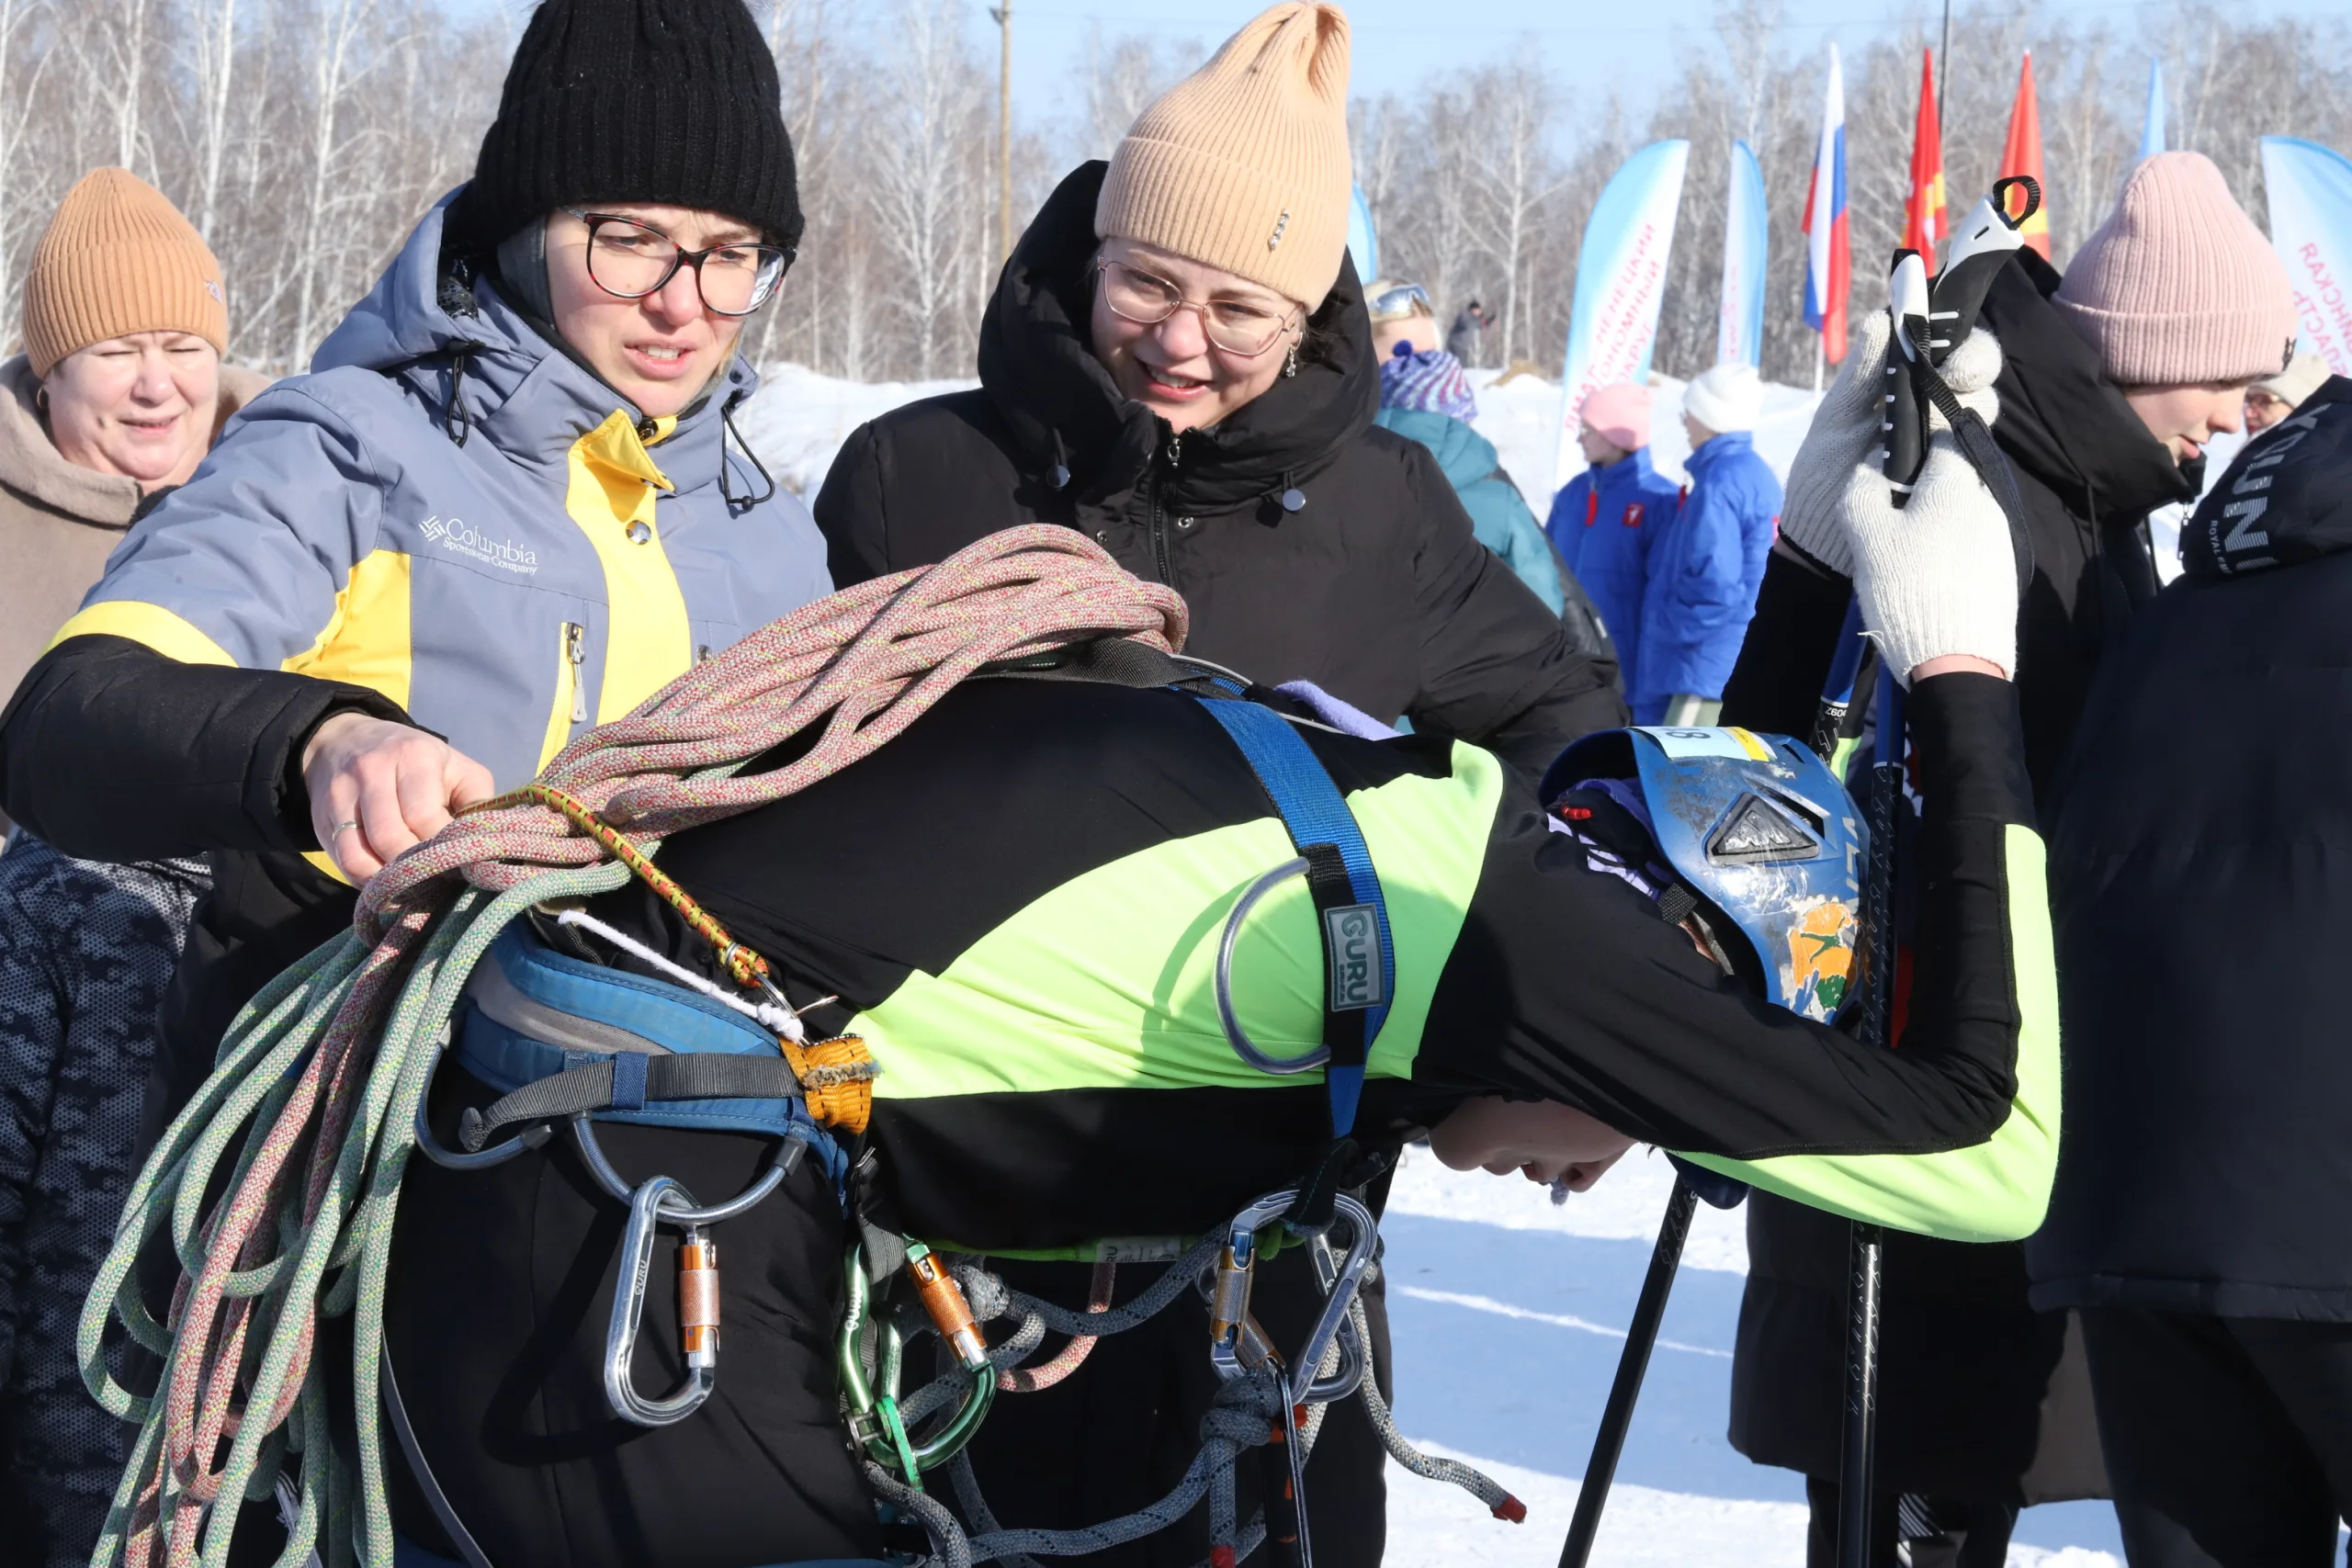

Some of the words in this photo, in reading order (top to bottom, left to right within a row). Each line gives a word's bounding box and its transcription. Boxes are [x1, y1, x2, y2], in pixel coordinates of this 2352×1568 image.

[447, 518, 538, 565] Columbia
[2209, 520, 2221, 555] ROYAL
[492, 556, 537, 576] Company
[1341, 911, 1369, 1001] GURU
[635, 1259, 647, 1295] GURU
